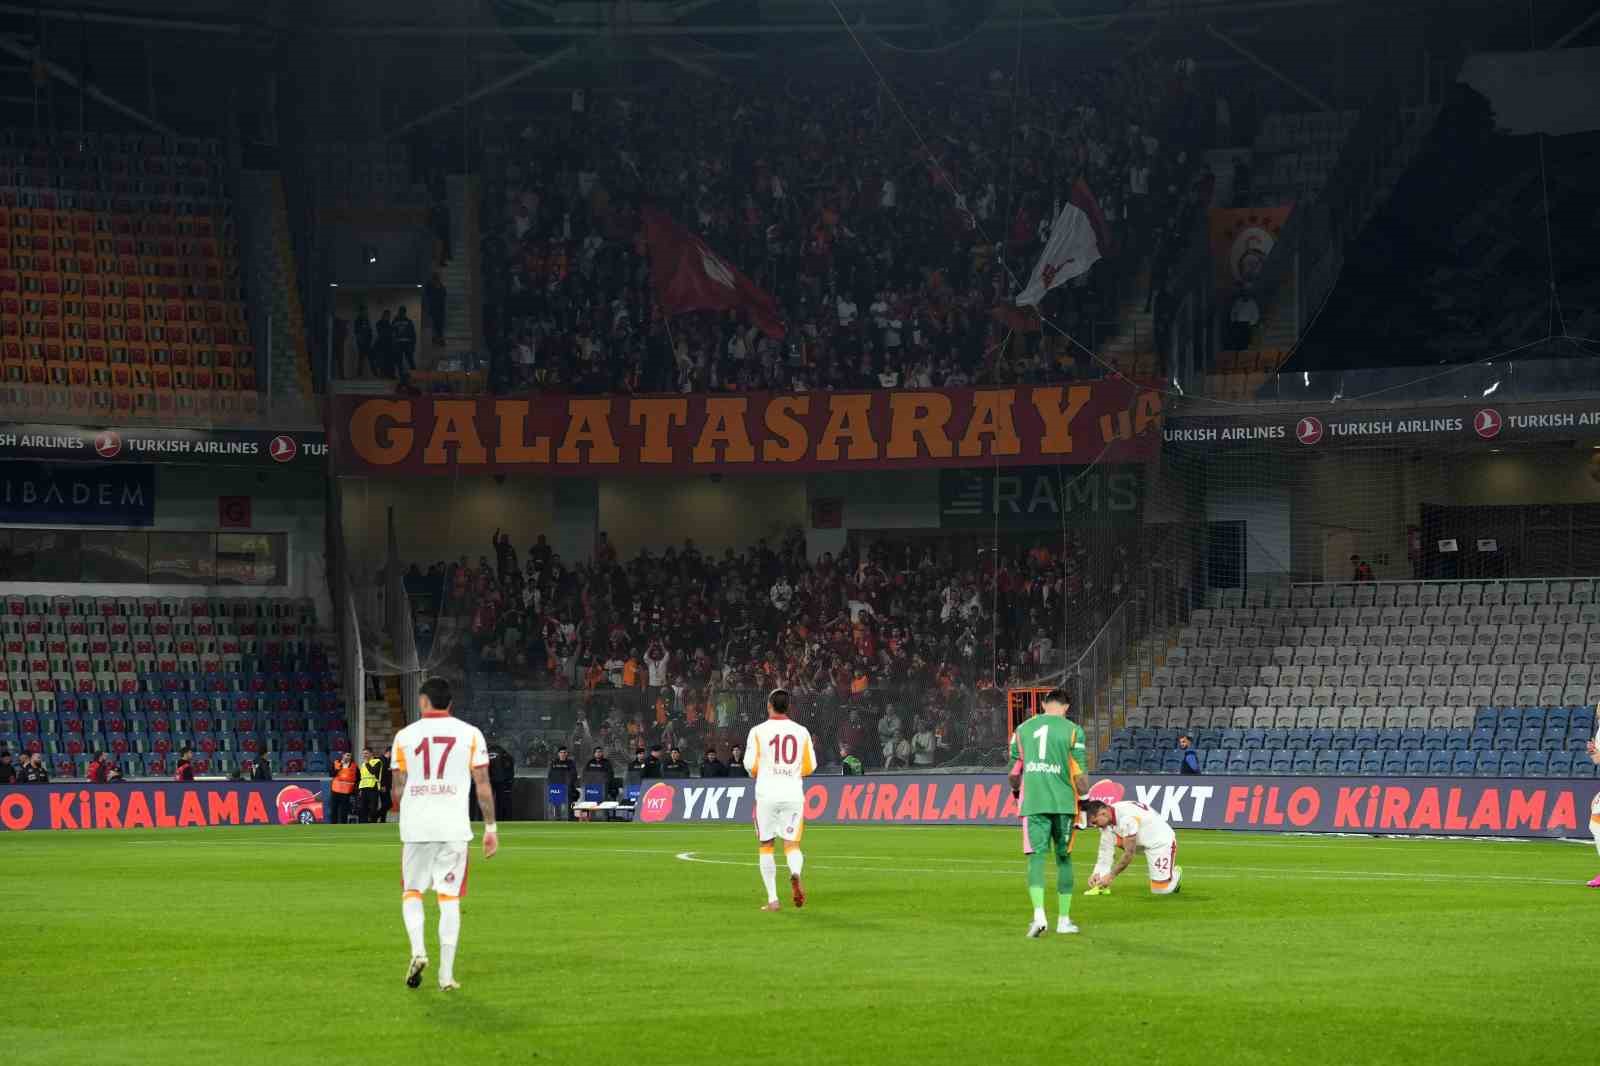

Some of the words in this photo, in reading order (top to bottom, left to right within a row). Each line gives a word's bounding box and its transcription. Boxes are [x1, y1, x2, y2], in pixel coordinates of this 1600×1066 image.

[349, 385, 1092, 465] GALATASARAY
[1329, 421, 1393, 435] TURKISH
[1396, 418, 1464, 434] AIRLINES
[1508, 414, 1575, 429] TURKISH
[20, 434, 84, 450] AIRLINES
[1163, 427, 1217, 442] URKISH
[1221, 426, 1286, 440] AIRLINES
[127, 438, 191, 453] TURKISH
[194, 440, 259, 455] AIRLINES
[993, 474, 1138, 513] RAMS
[769, 734, 798, 765] 10
[1032, 724, 1049, 760] 1
[414, 736, 457, 780] 17
[682, 787, 746, 820] YKT
[1154, 857, 1170, 871] 42
